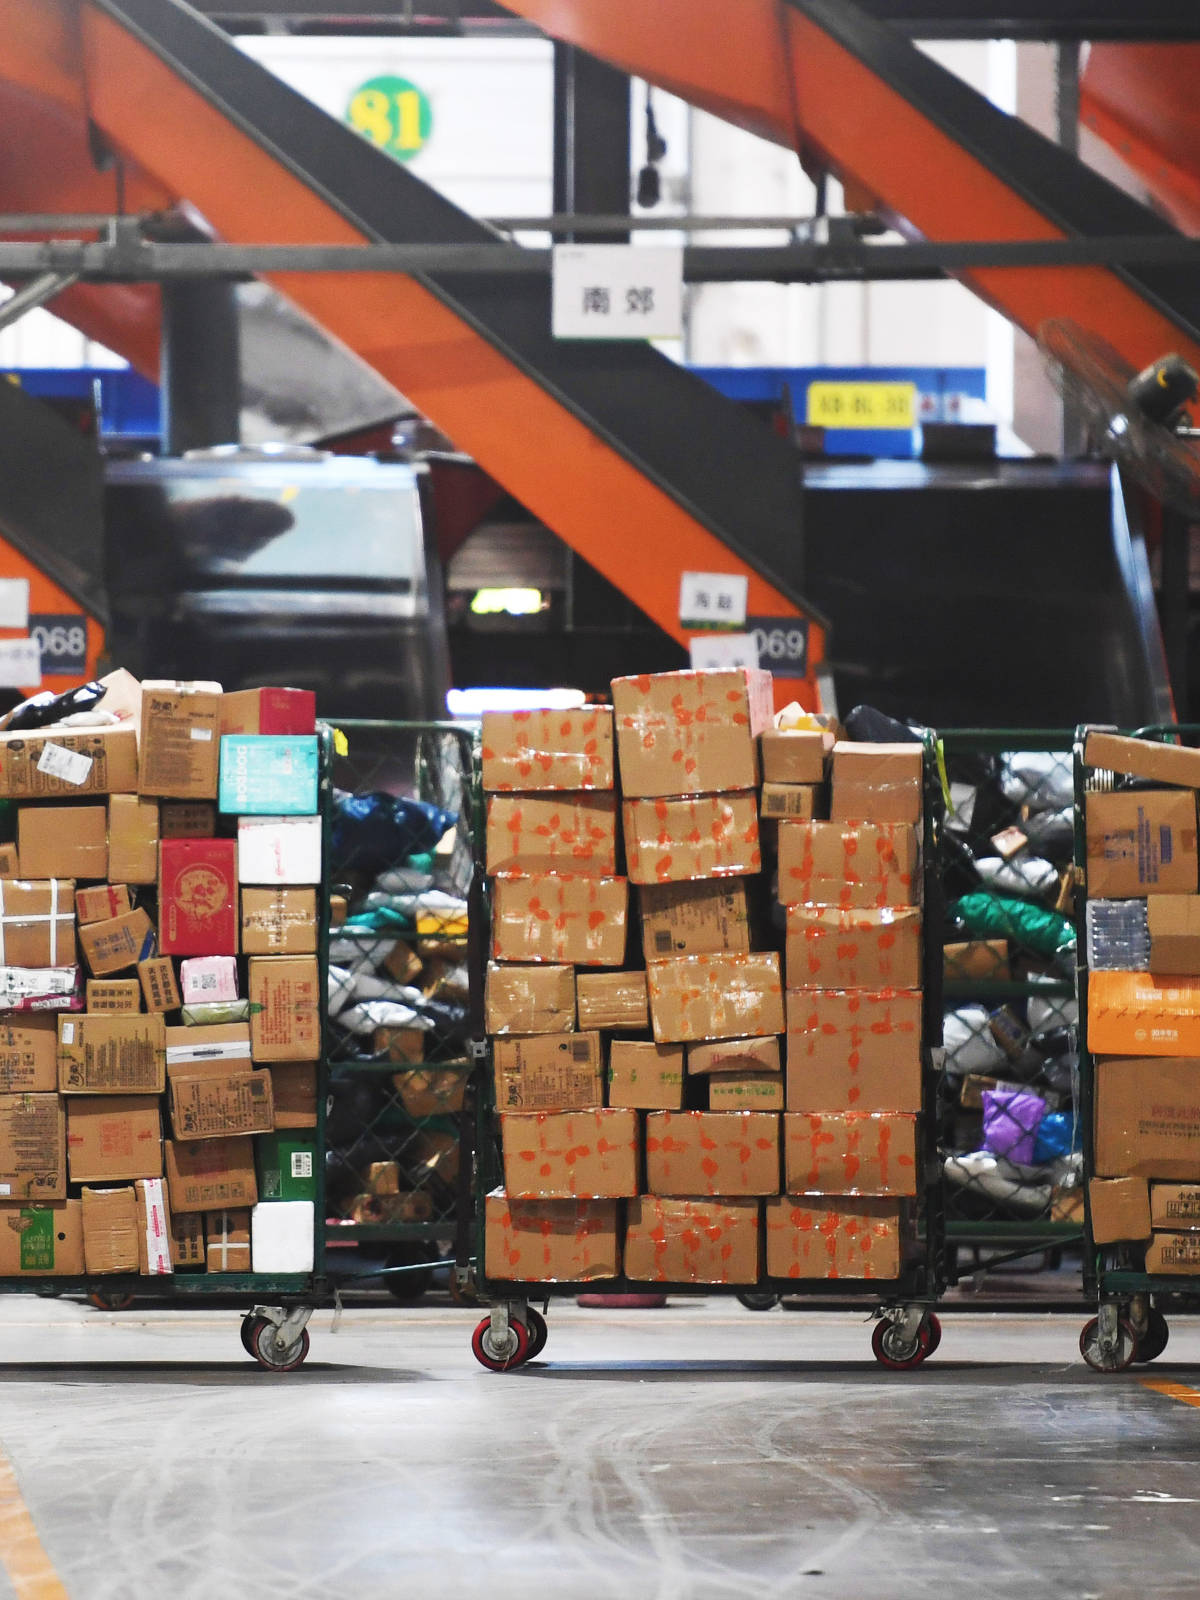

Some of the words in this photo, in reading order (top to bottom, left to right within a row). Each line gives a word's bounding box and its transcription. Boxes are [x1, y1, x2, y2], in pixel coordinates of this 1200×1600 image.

[350, 89, 424, 149] 81
[31, 625, 86, 656] 068
[751, 628, 805, 659] 069
